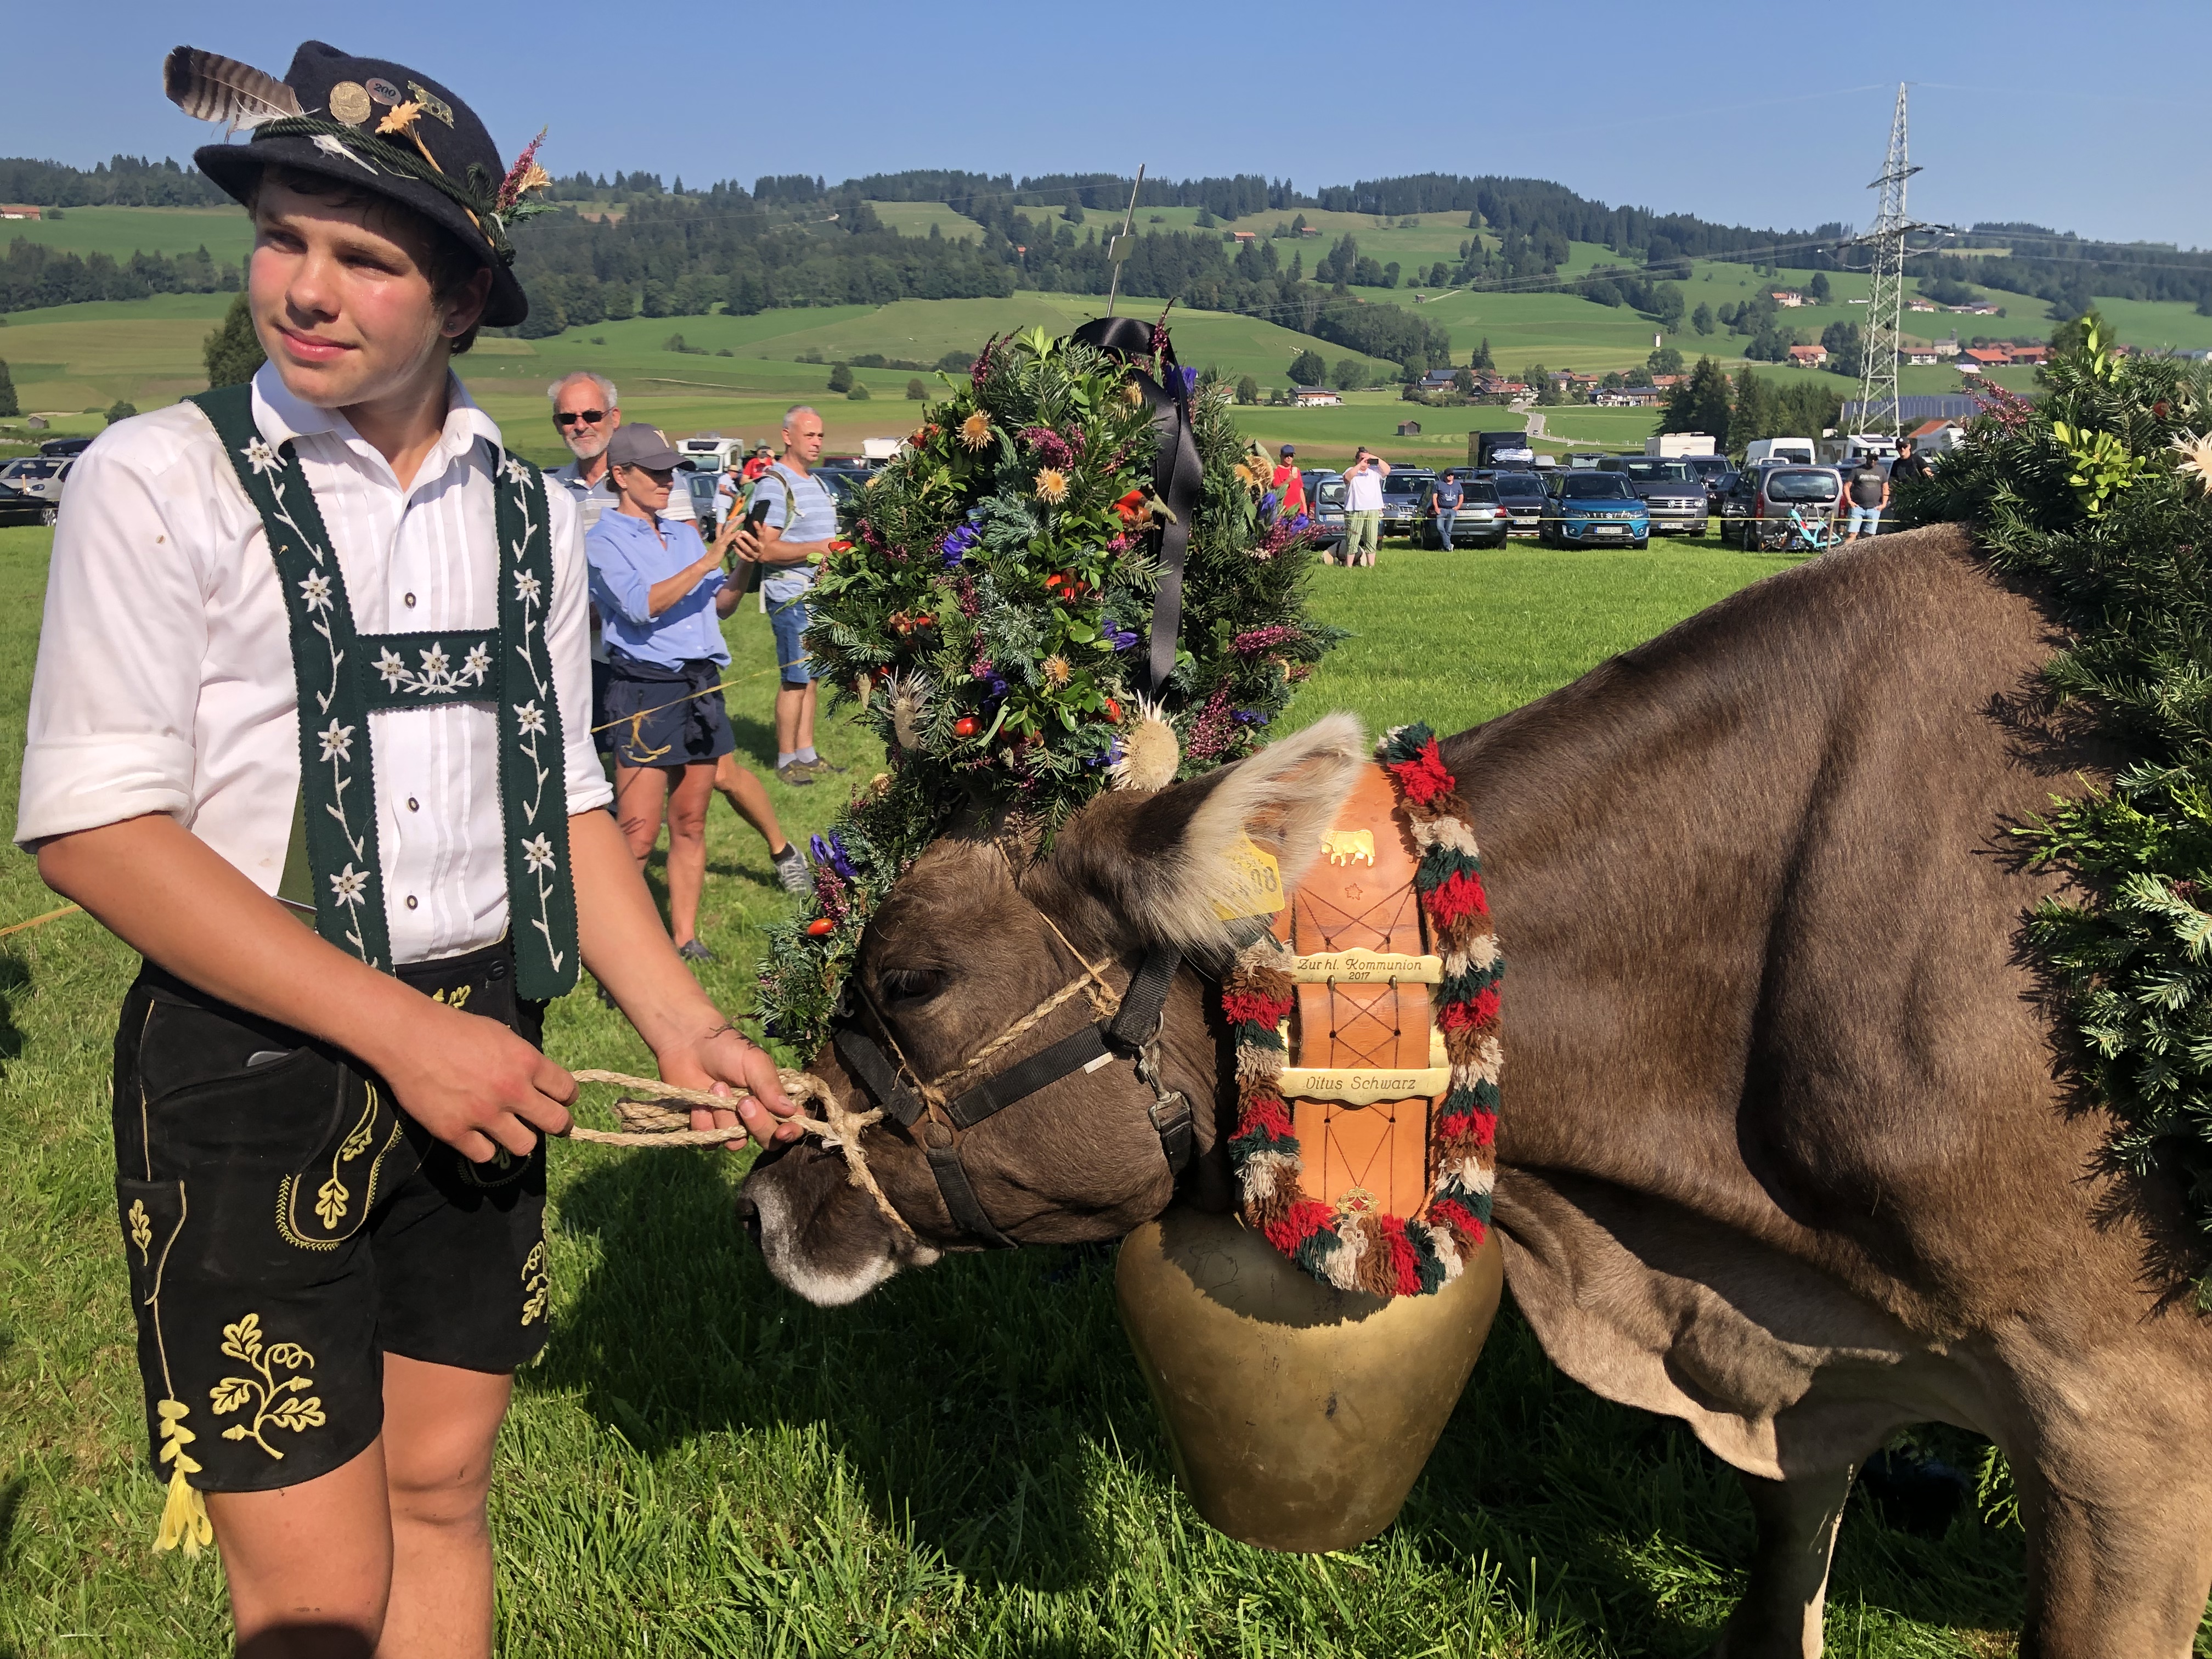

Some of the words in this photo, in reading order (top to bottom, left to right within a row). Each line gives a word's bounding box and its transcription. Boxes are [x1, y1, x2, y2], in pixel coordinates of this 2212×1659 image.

[374, 83, 396, 97] 200
[1297, 958, 1323, 970] Zur
[1324, 958, 1340, 970] hl.
[1345, 958, 1422, 970] Kommunion
[1348, 972, 1370, 980] 2017
[1351, 1076, 1416, 1090] Schwarz
